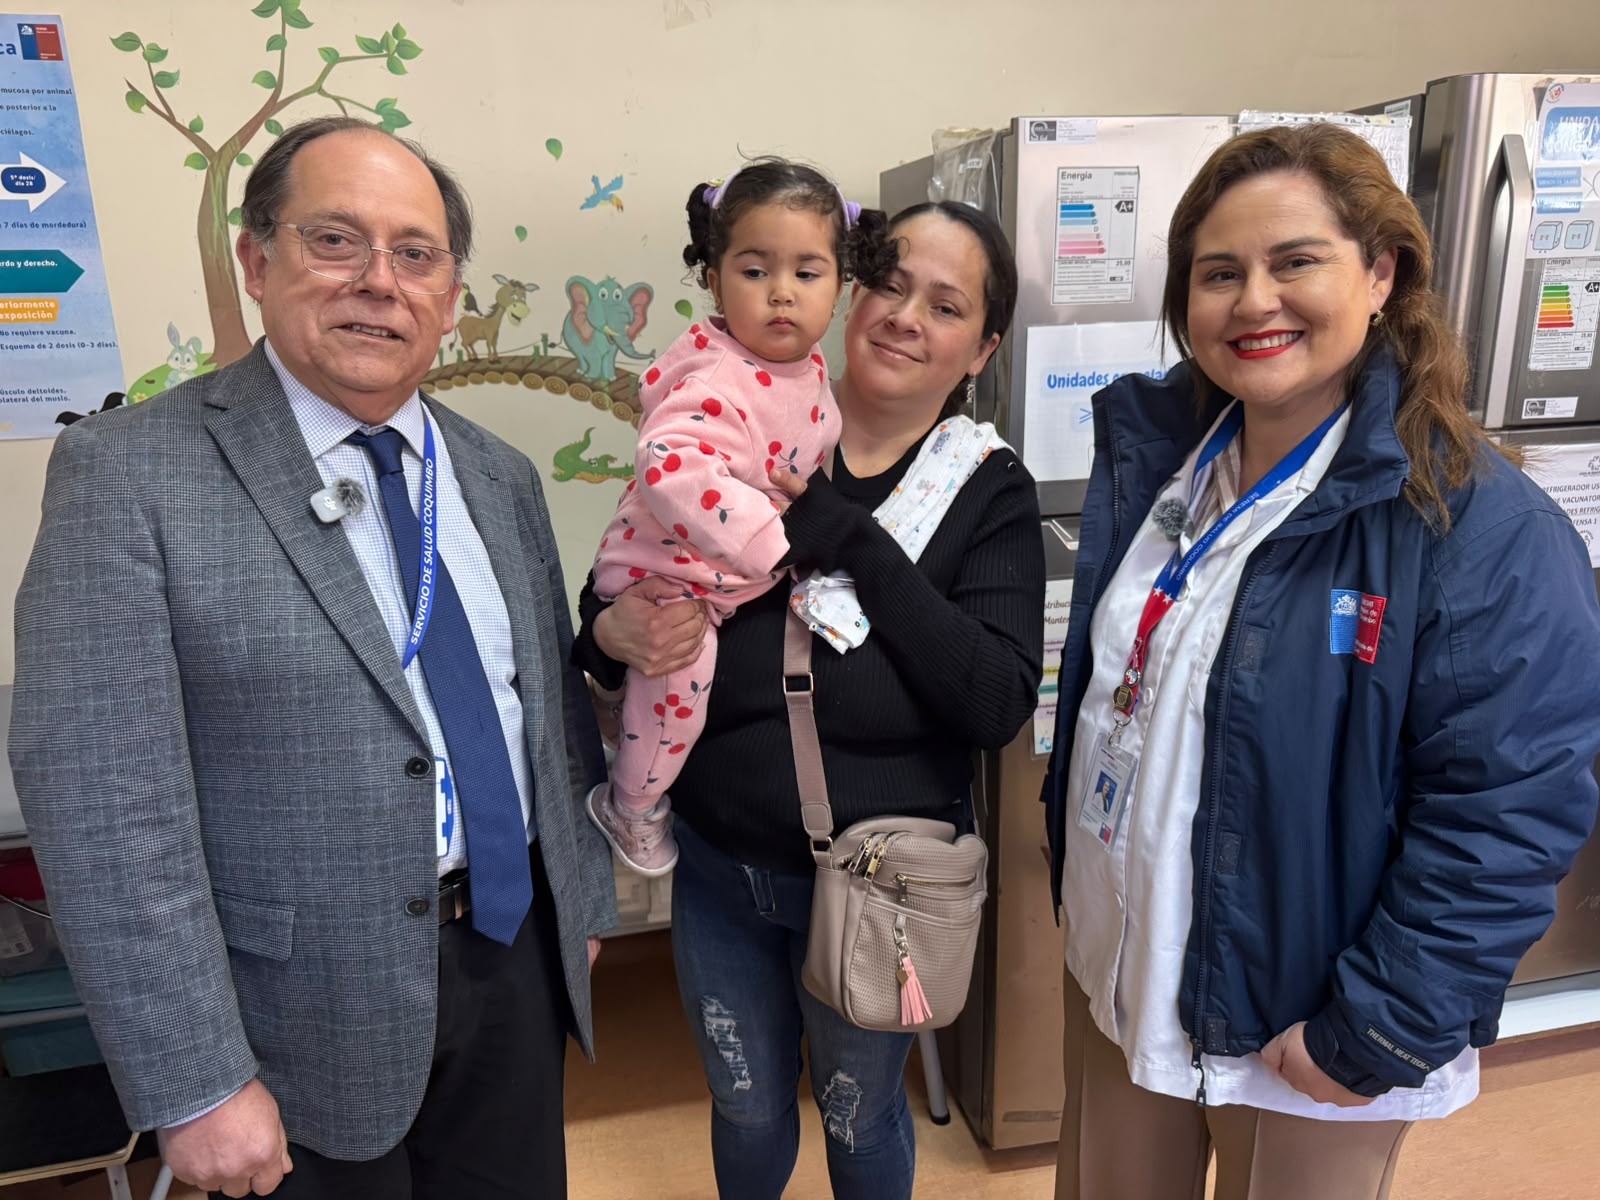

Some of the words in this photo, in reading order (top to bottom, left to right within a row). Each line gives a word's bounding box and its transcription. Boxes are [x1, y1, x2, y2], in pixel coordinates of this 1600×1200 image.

[31, 88, 45, 96] por
[6, 104, 41, 112] posterior
[1118, 201, 1134, 213] A+
[4, 221, 9, 229] 7
[11, 220, 28, 229] días
[29, 221, 40, 229] de
[41, 220, 87, 229] mordedura)
[24, 259, 58, 267] derecho.
[0, 310, 53, 320] exposición
[11, 329, 44, 337] requiere
[0, 343, 35, 351] Esquema
[55, 341, 76, 349] dosis
[1047, 371, 1109, 389] Unidades
[27, 387, 67, 395] deltoides.
[31, 395, 43, 403] del
[45, 395, 71, 403] muslo.
[423, 457, 434, 524] COQUIMBO
[1222, 513, 1233, 523] DE
[1202, 521, 1223, 544] SALUD
[423, 526, 434, 565] SALUD
[1176, 544, 1204, 581] COQUIMBO
[422, 566, 432, 583] DE
[411, 585, 431, 646] SERVICIO
[1366, 1027, 1395, 1053] THERMAL
[1393, 1047, 1412, 1061] HEAT
